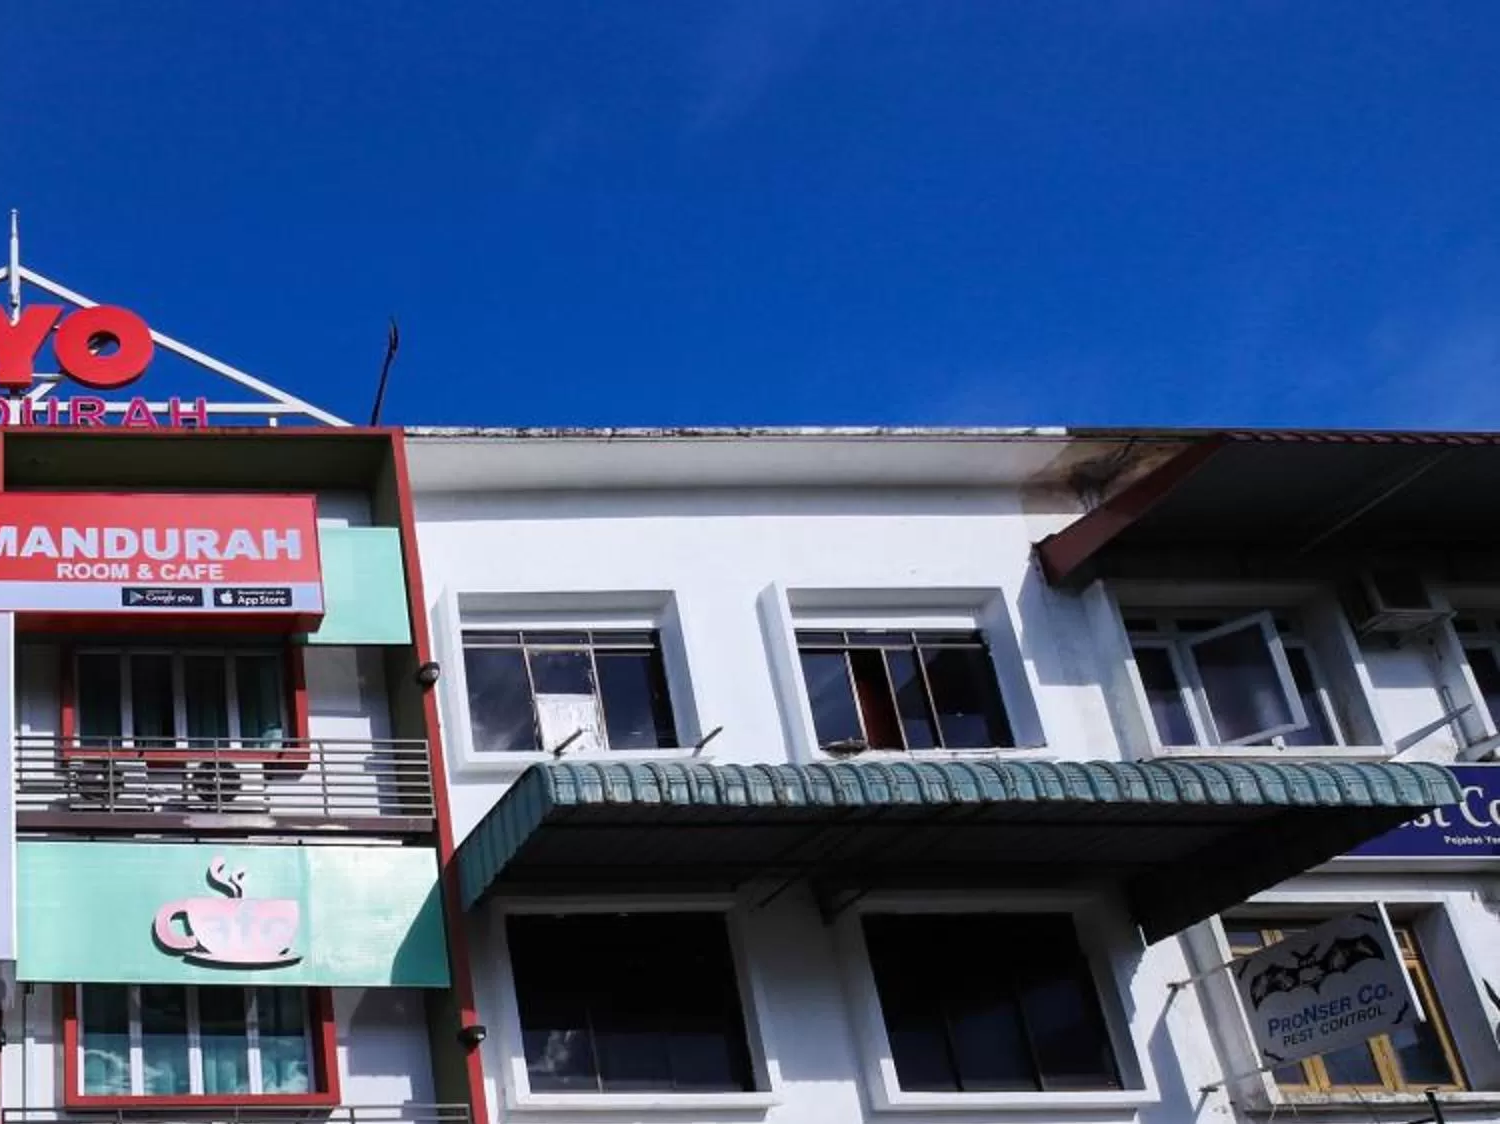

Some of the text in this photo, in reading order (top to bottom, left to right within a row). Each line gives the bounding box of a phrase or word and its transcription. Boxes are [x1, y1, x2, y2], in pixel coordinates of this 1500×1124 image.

[57, 563, 224, 581] ROOM & CAFE
[1283, 1006, 1384, 1047] PEST CONTROL
